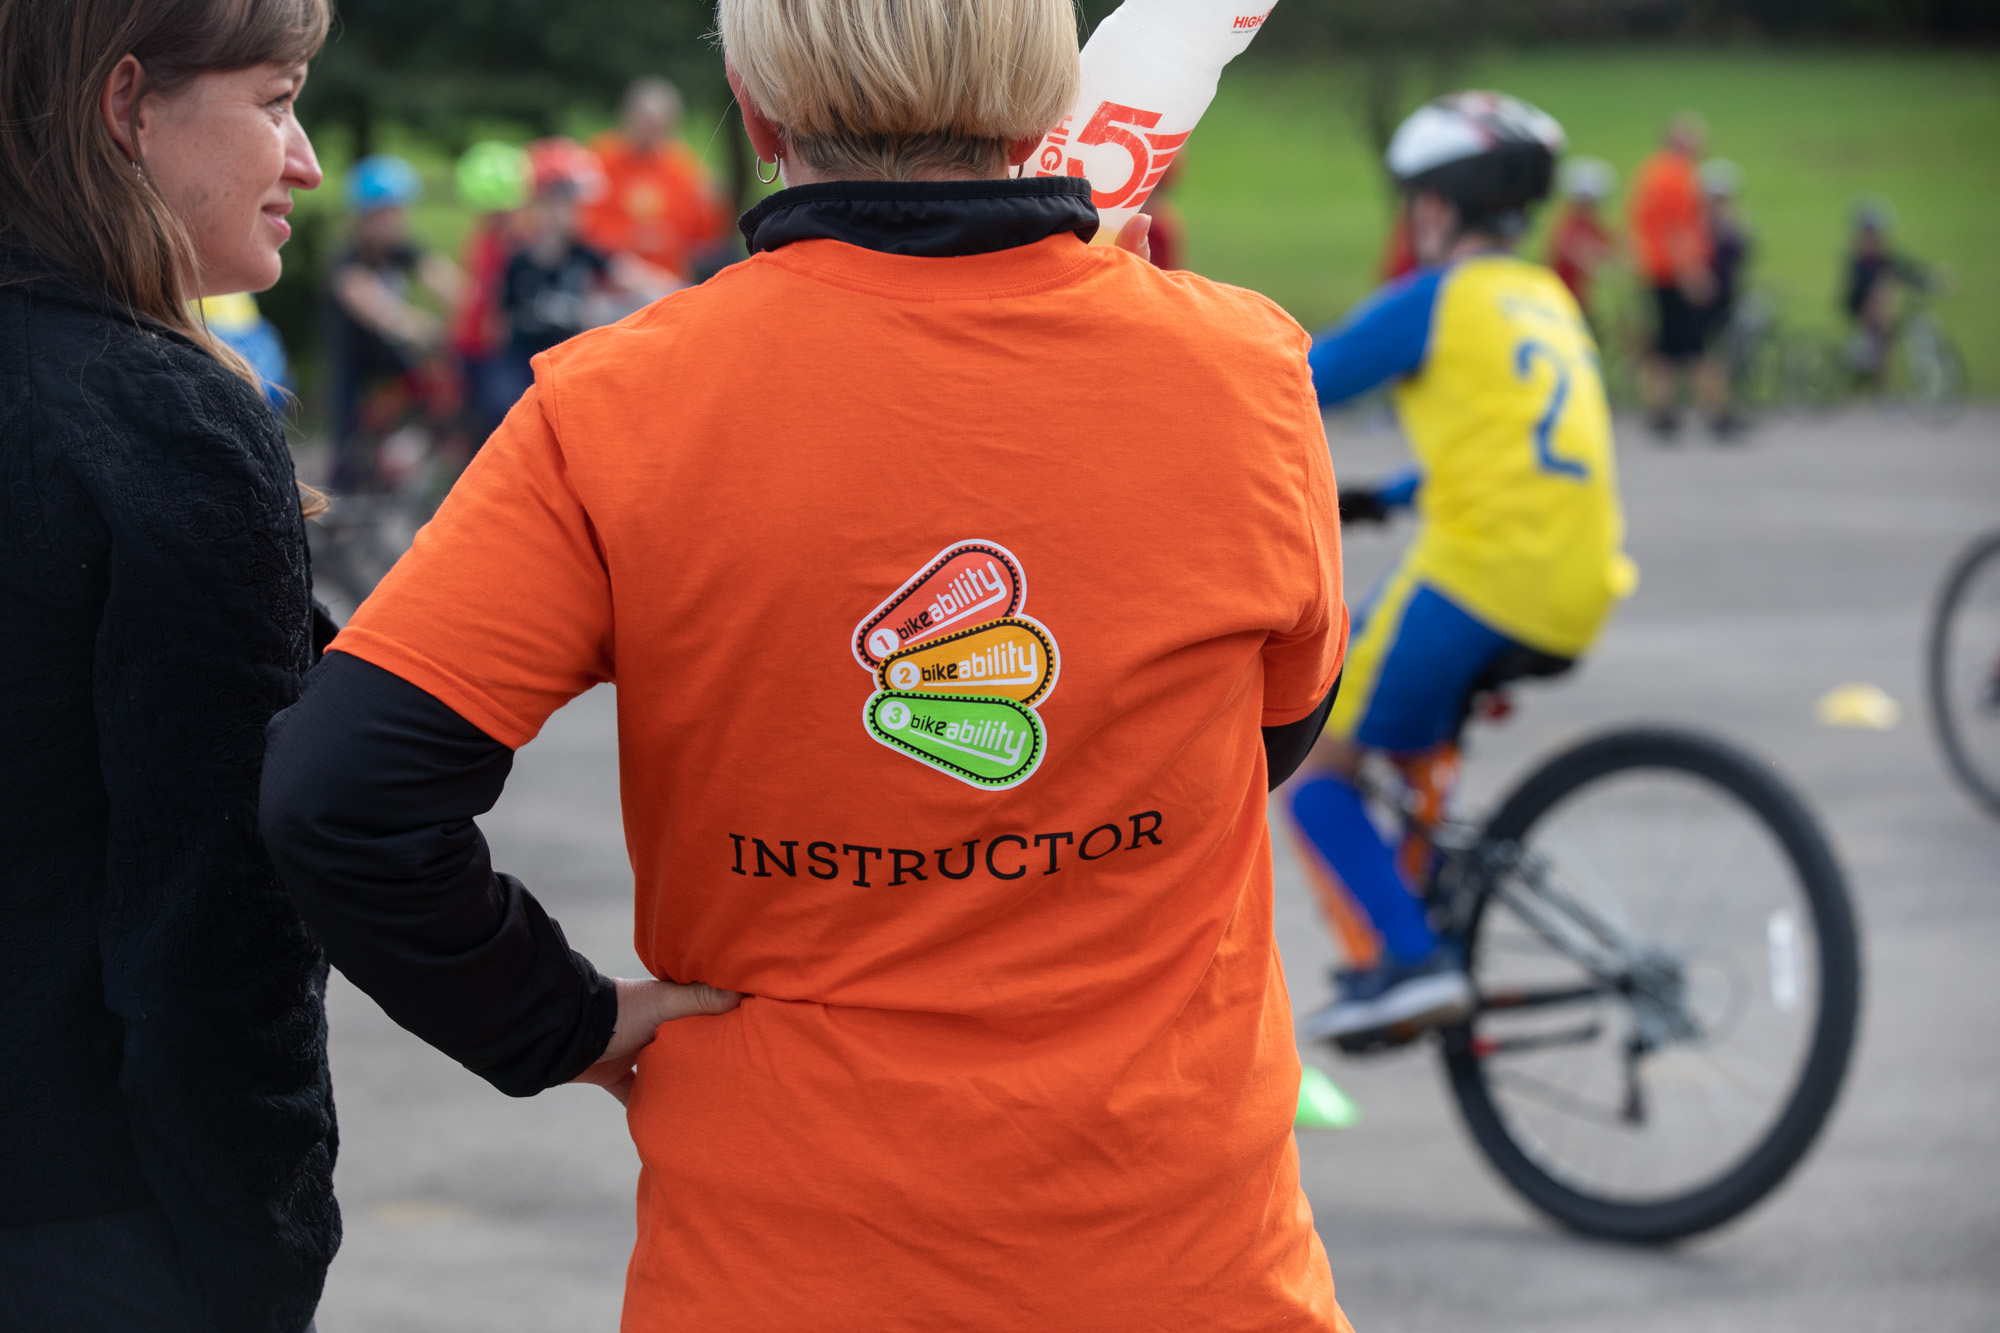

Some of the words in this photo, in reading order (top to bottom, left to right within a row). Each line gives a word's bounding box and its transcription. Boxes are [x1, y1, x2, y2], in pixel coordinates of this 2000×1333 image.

[1035, 114, 1073, 177] HIG
[877, 635, 890, 651] 1
[897, 561, 1006, 644] bikeability
[899, 667, 912, 684] 2
[921, 641, 1038, 686] bikeability
[888, 706, 903, 725] 3
[909, 713, 1026, 766] bikeability
[729, 810, 1163, 888] INSTRUCTOR
